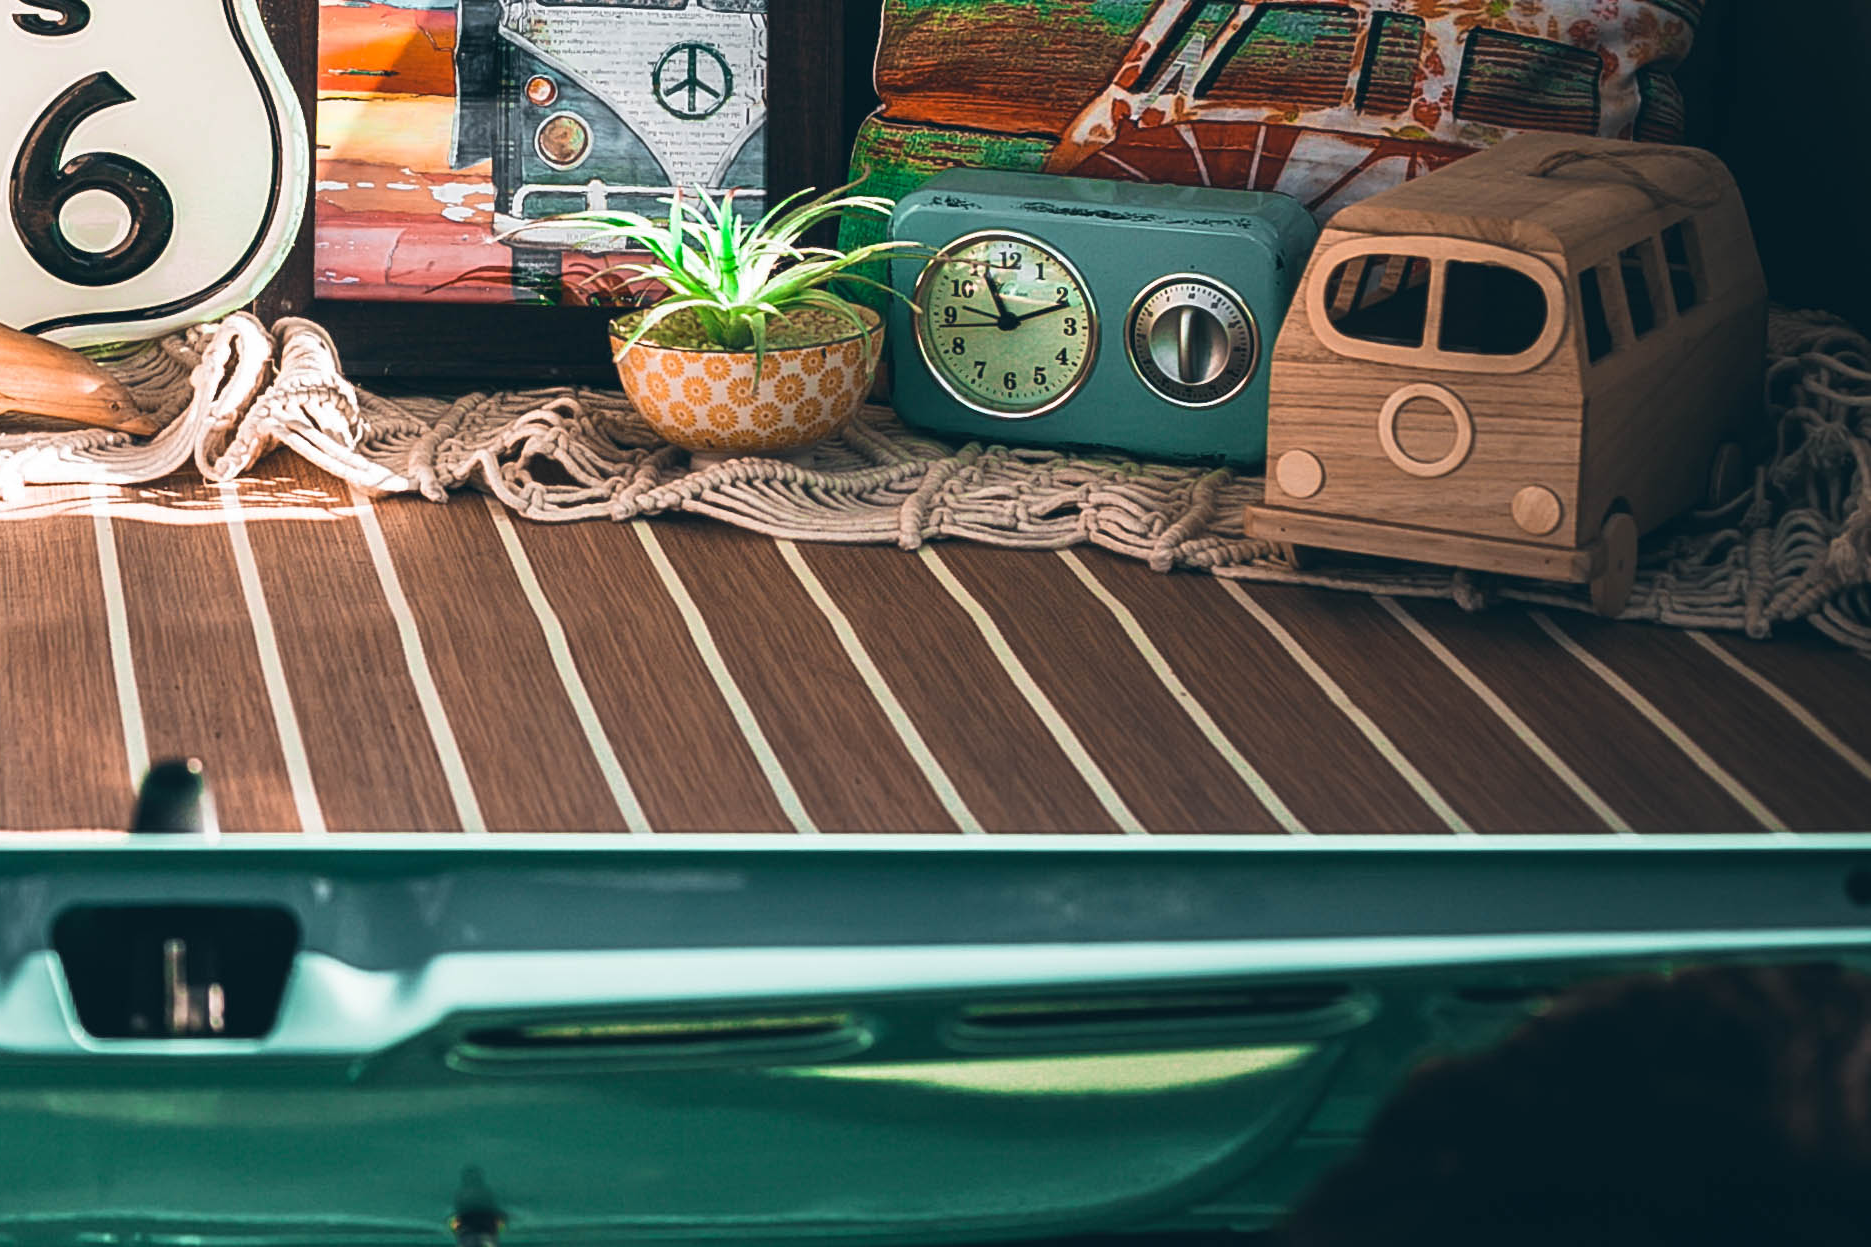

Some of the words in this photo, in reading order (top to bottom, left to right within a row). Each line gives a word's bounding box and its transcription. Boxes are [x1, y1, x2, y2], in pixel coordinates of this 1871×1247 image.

[999, 252, 1022, 270] 12
[1036, 263, 1046, 280] 1
[951, 279, 974, 298] 10
[1056, 287, 1069, 305] 2
[944, 306, 958, 324] 9
[1063, 317, 1077, 336] 3
[952, 337, 965, 355] 8
[1055, 347, 1069, 366] 4
[974, 361, 987, 379] 7
[1033, 367, 1047, 385] 5
[1003, 372, 1017, 390] 6
